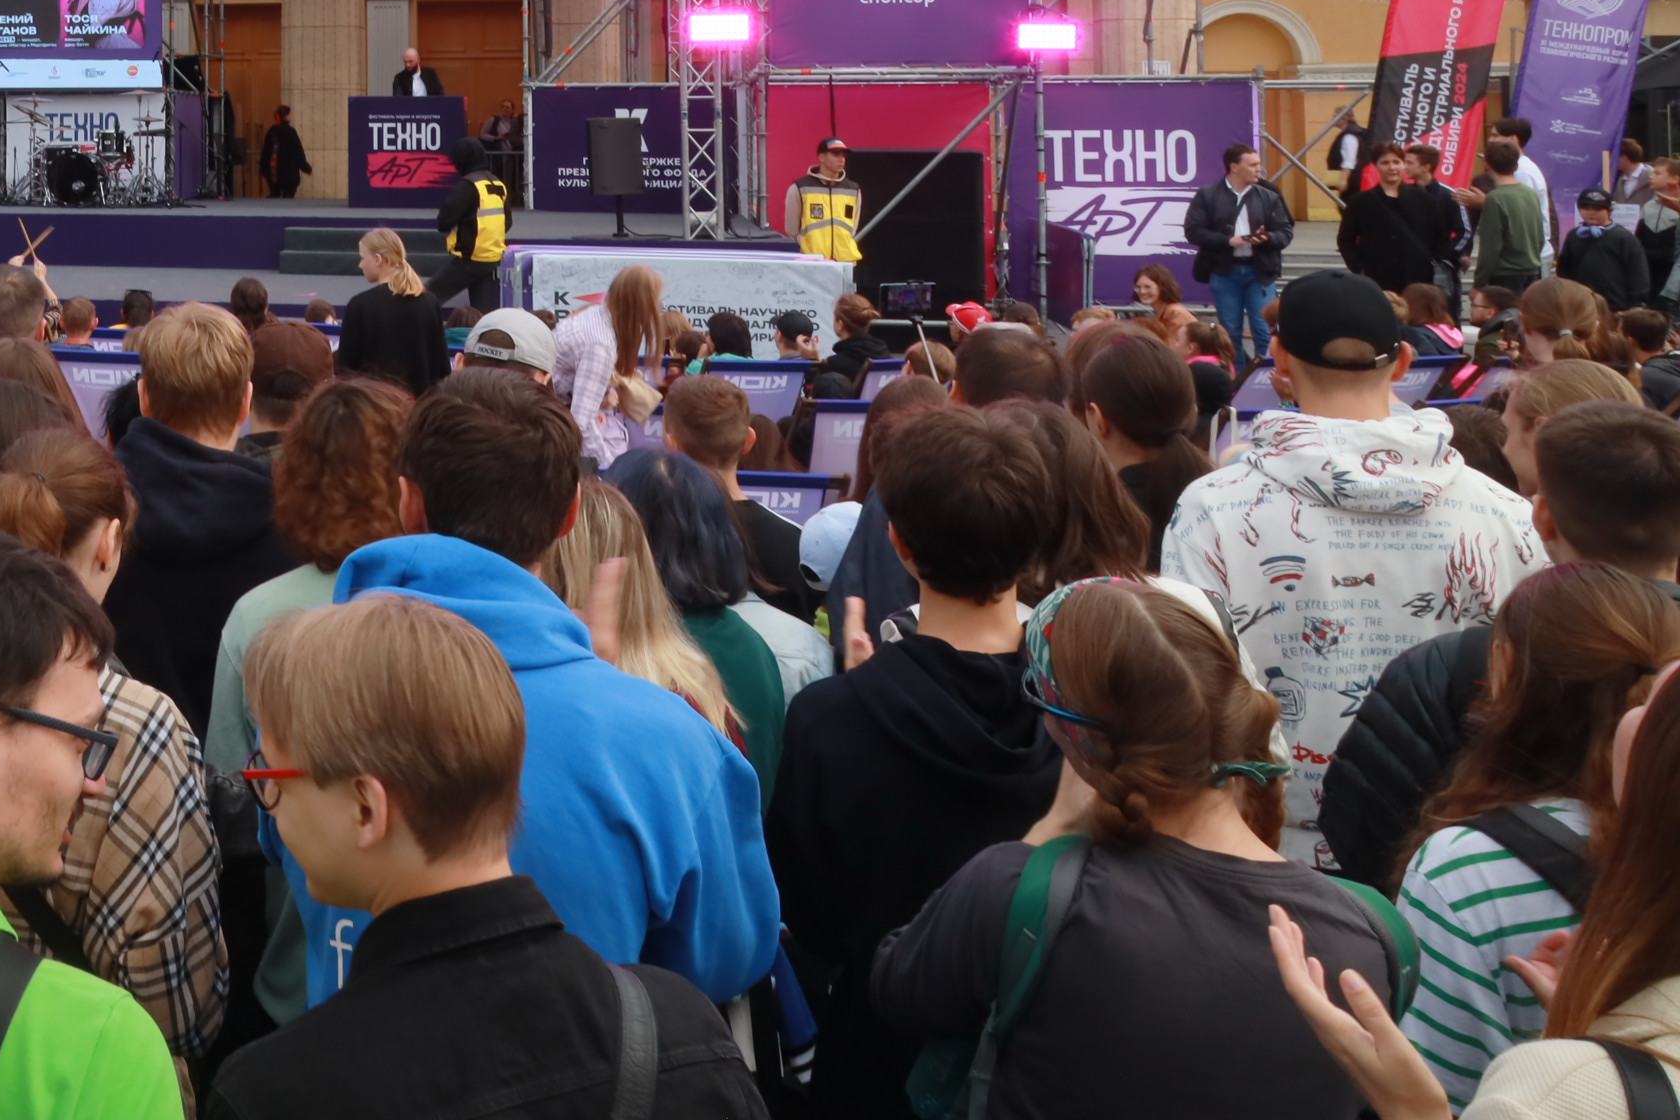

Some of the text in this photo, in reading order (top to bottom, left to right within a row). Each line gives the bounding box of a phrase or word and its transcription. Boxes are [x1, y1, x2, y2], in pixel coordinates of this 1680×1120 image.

[64, 14, 98, 23] ТОСЯ
[64, 24, 128, 34] ЧАЙКИНА
[1544, 18, 1634, 47] ТЕХНОПРОМ
[1428, 6, 1462, 151] ДУСТРИАЛЬНОГО
[1393, 63, 1420, 149] ЕСТИВАЛЬ
[1410, 82, 1434, 147] УЧНОГО
[1441, 62, 1469, 176] СИБИРИ 2024
[45, 112, 121, 142] ТЕХНО
[368, 122, 440, 150] ТЕХНО
[1044, 129, 1197, 182] ТЕХНО
[663, 167, 707, 178] ФОДА
[1435, 497, 1464, 510] EADS
[1295, 599, 1354, 612] EXPRESSION
[1360, 598, 1382, 611] FOR
